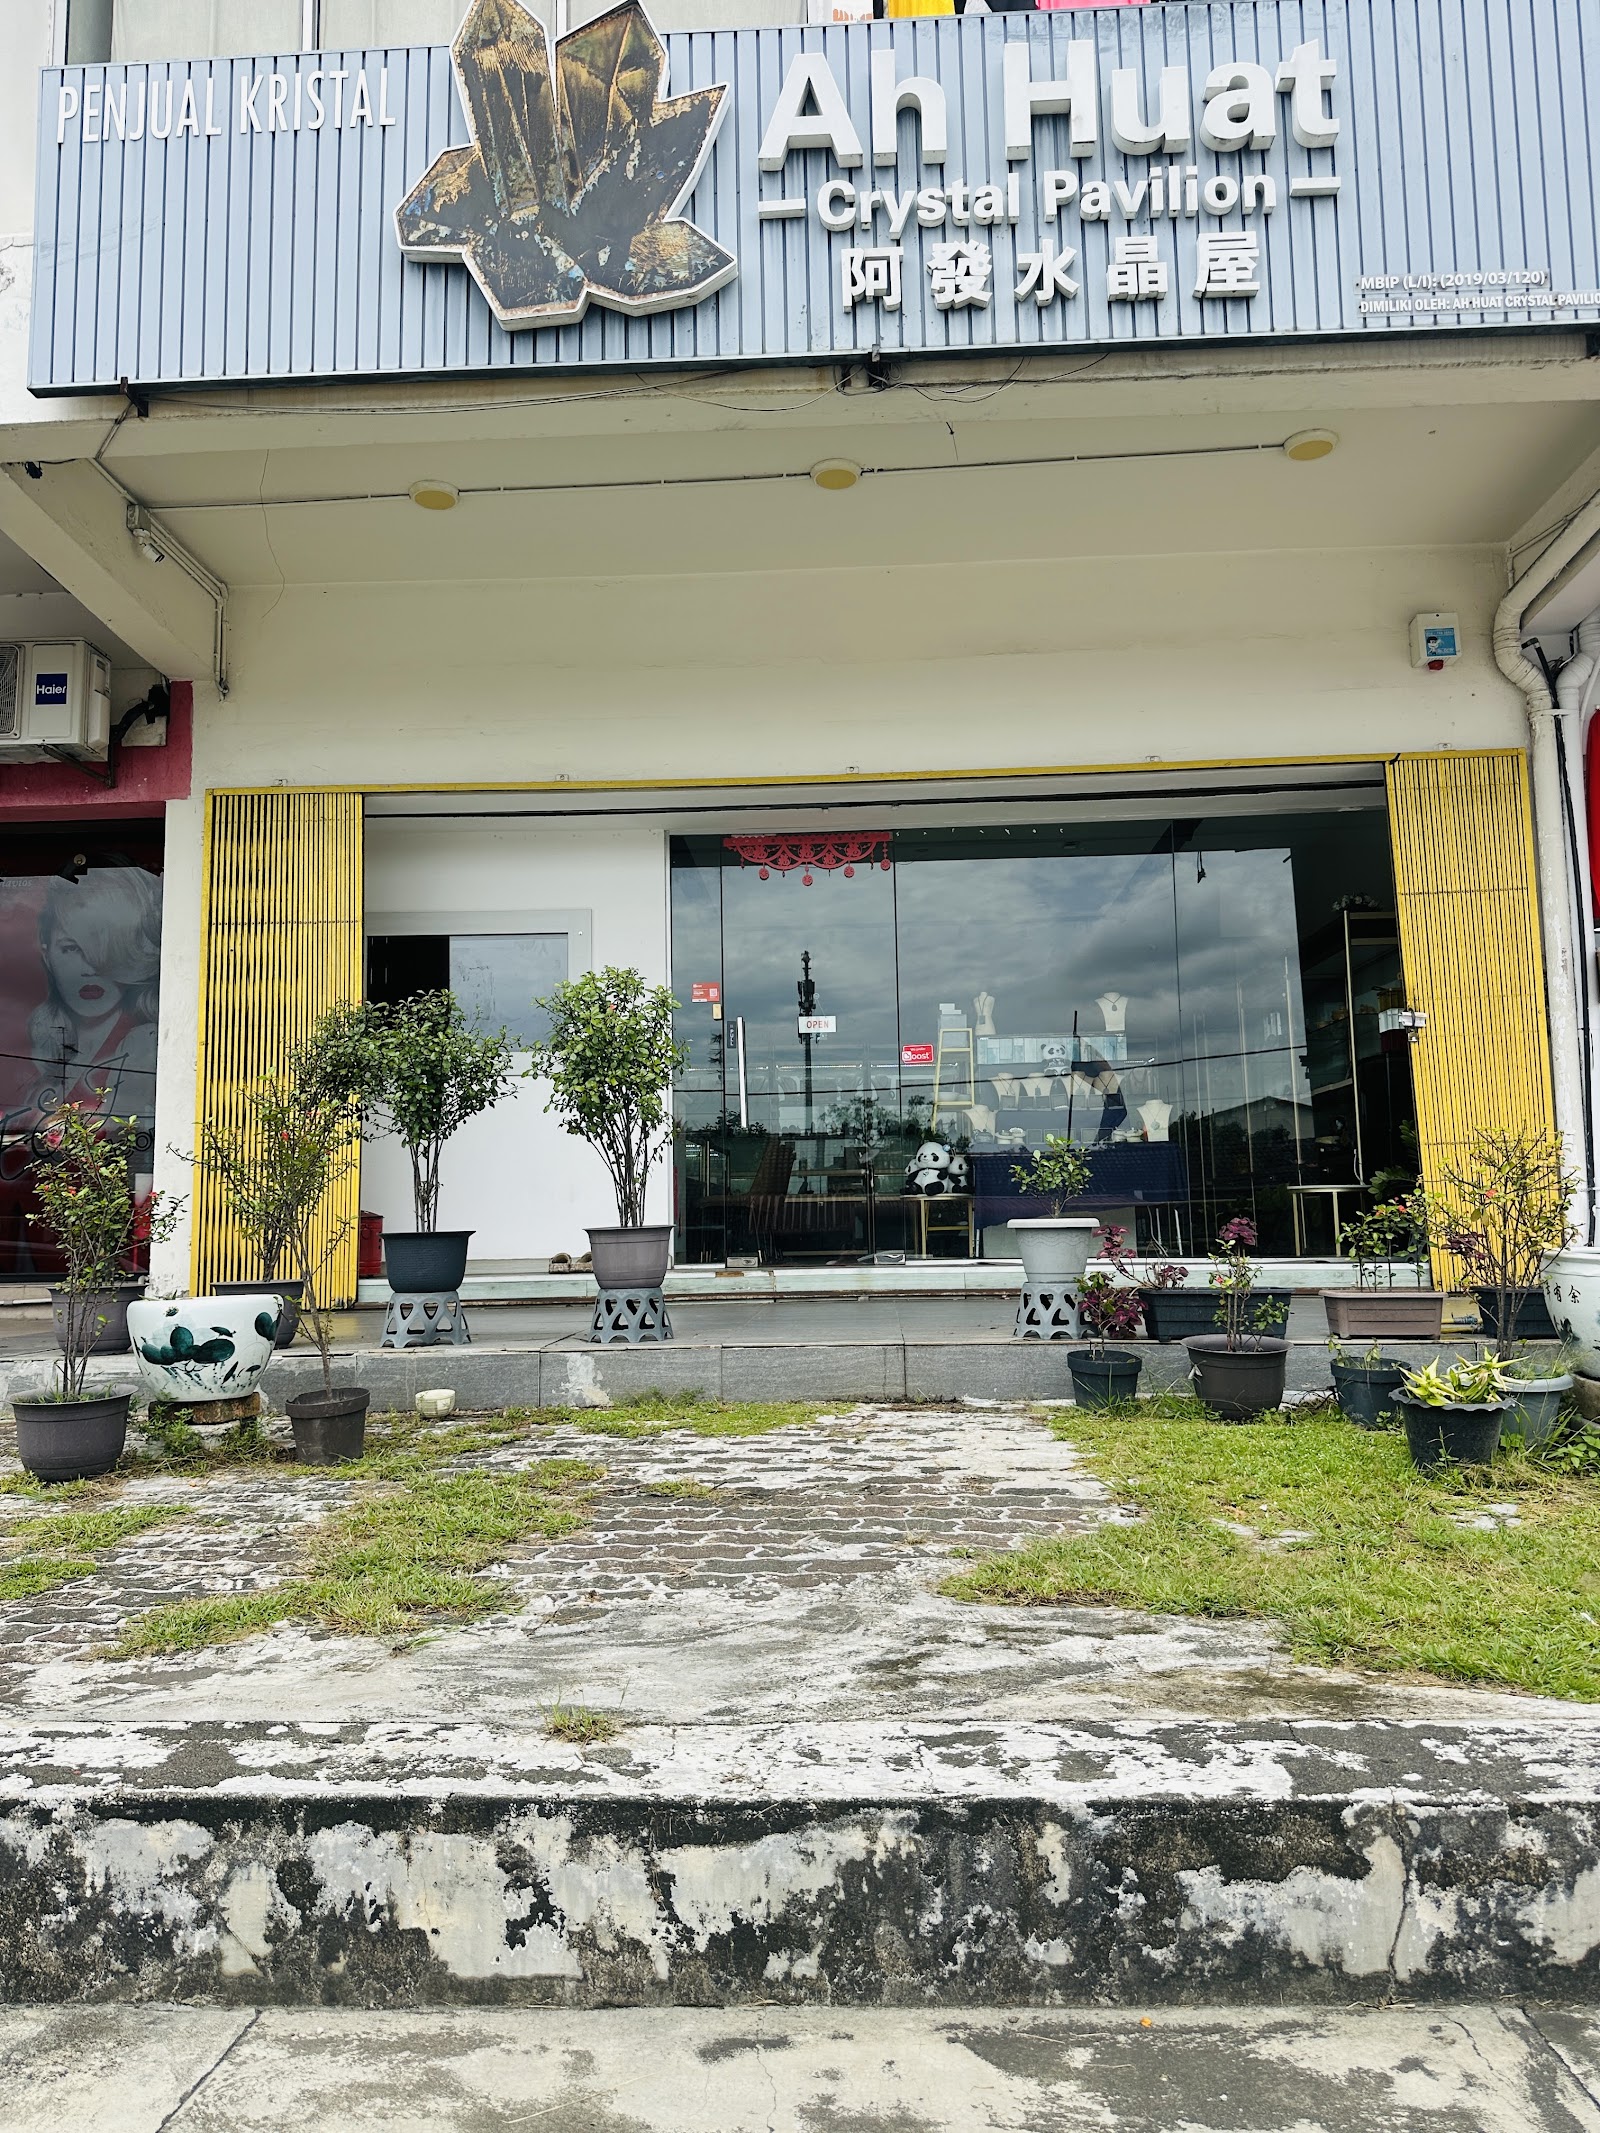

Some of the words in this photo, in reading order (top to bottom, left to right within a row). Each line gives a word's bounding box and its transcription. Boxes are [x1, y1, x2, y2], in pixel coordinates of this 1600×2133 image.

[57, 77, 222, 144] PENJUAL
[241, 67, 396, 134] KRISTAL
[758, 49, 947, 171] Ah
[1004, 38, 1341, 161] Huat
[818, 172, 1019, 239] Crystal
[1045, 165, 1276, 223] Pavilion
[841, 231, 1260, 313] 阿發水晶屋
[1360, 276, 1400, 290] MBIP
[1440, 270, 1546, 289] (2019/03/120)
[1360, 299, 1412, 313] DIMILIKI
[1414, 298, 1450, 311] OLEH:
[1452, 298, 1470, 310] AH
[1472, 296, 1502, 309] HUAT
[1505, 294, 1556, 308] CRYSTAL
[36, 683, 66, 695] Haier
[806, 1020, 829, 1029] OPEN
